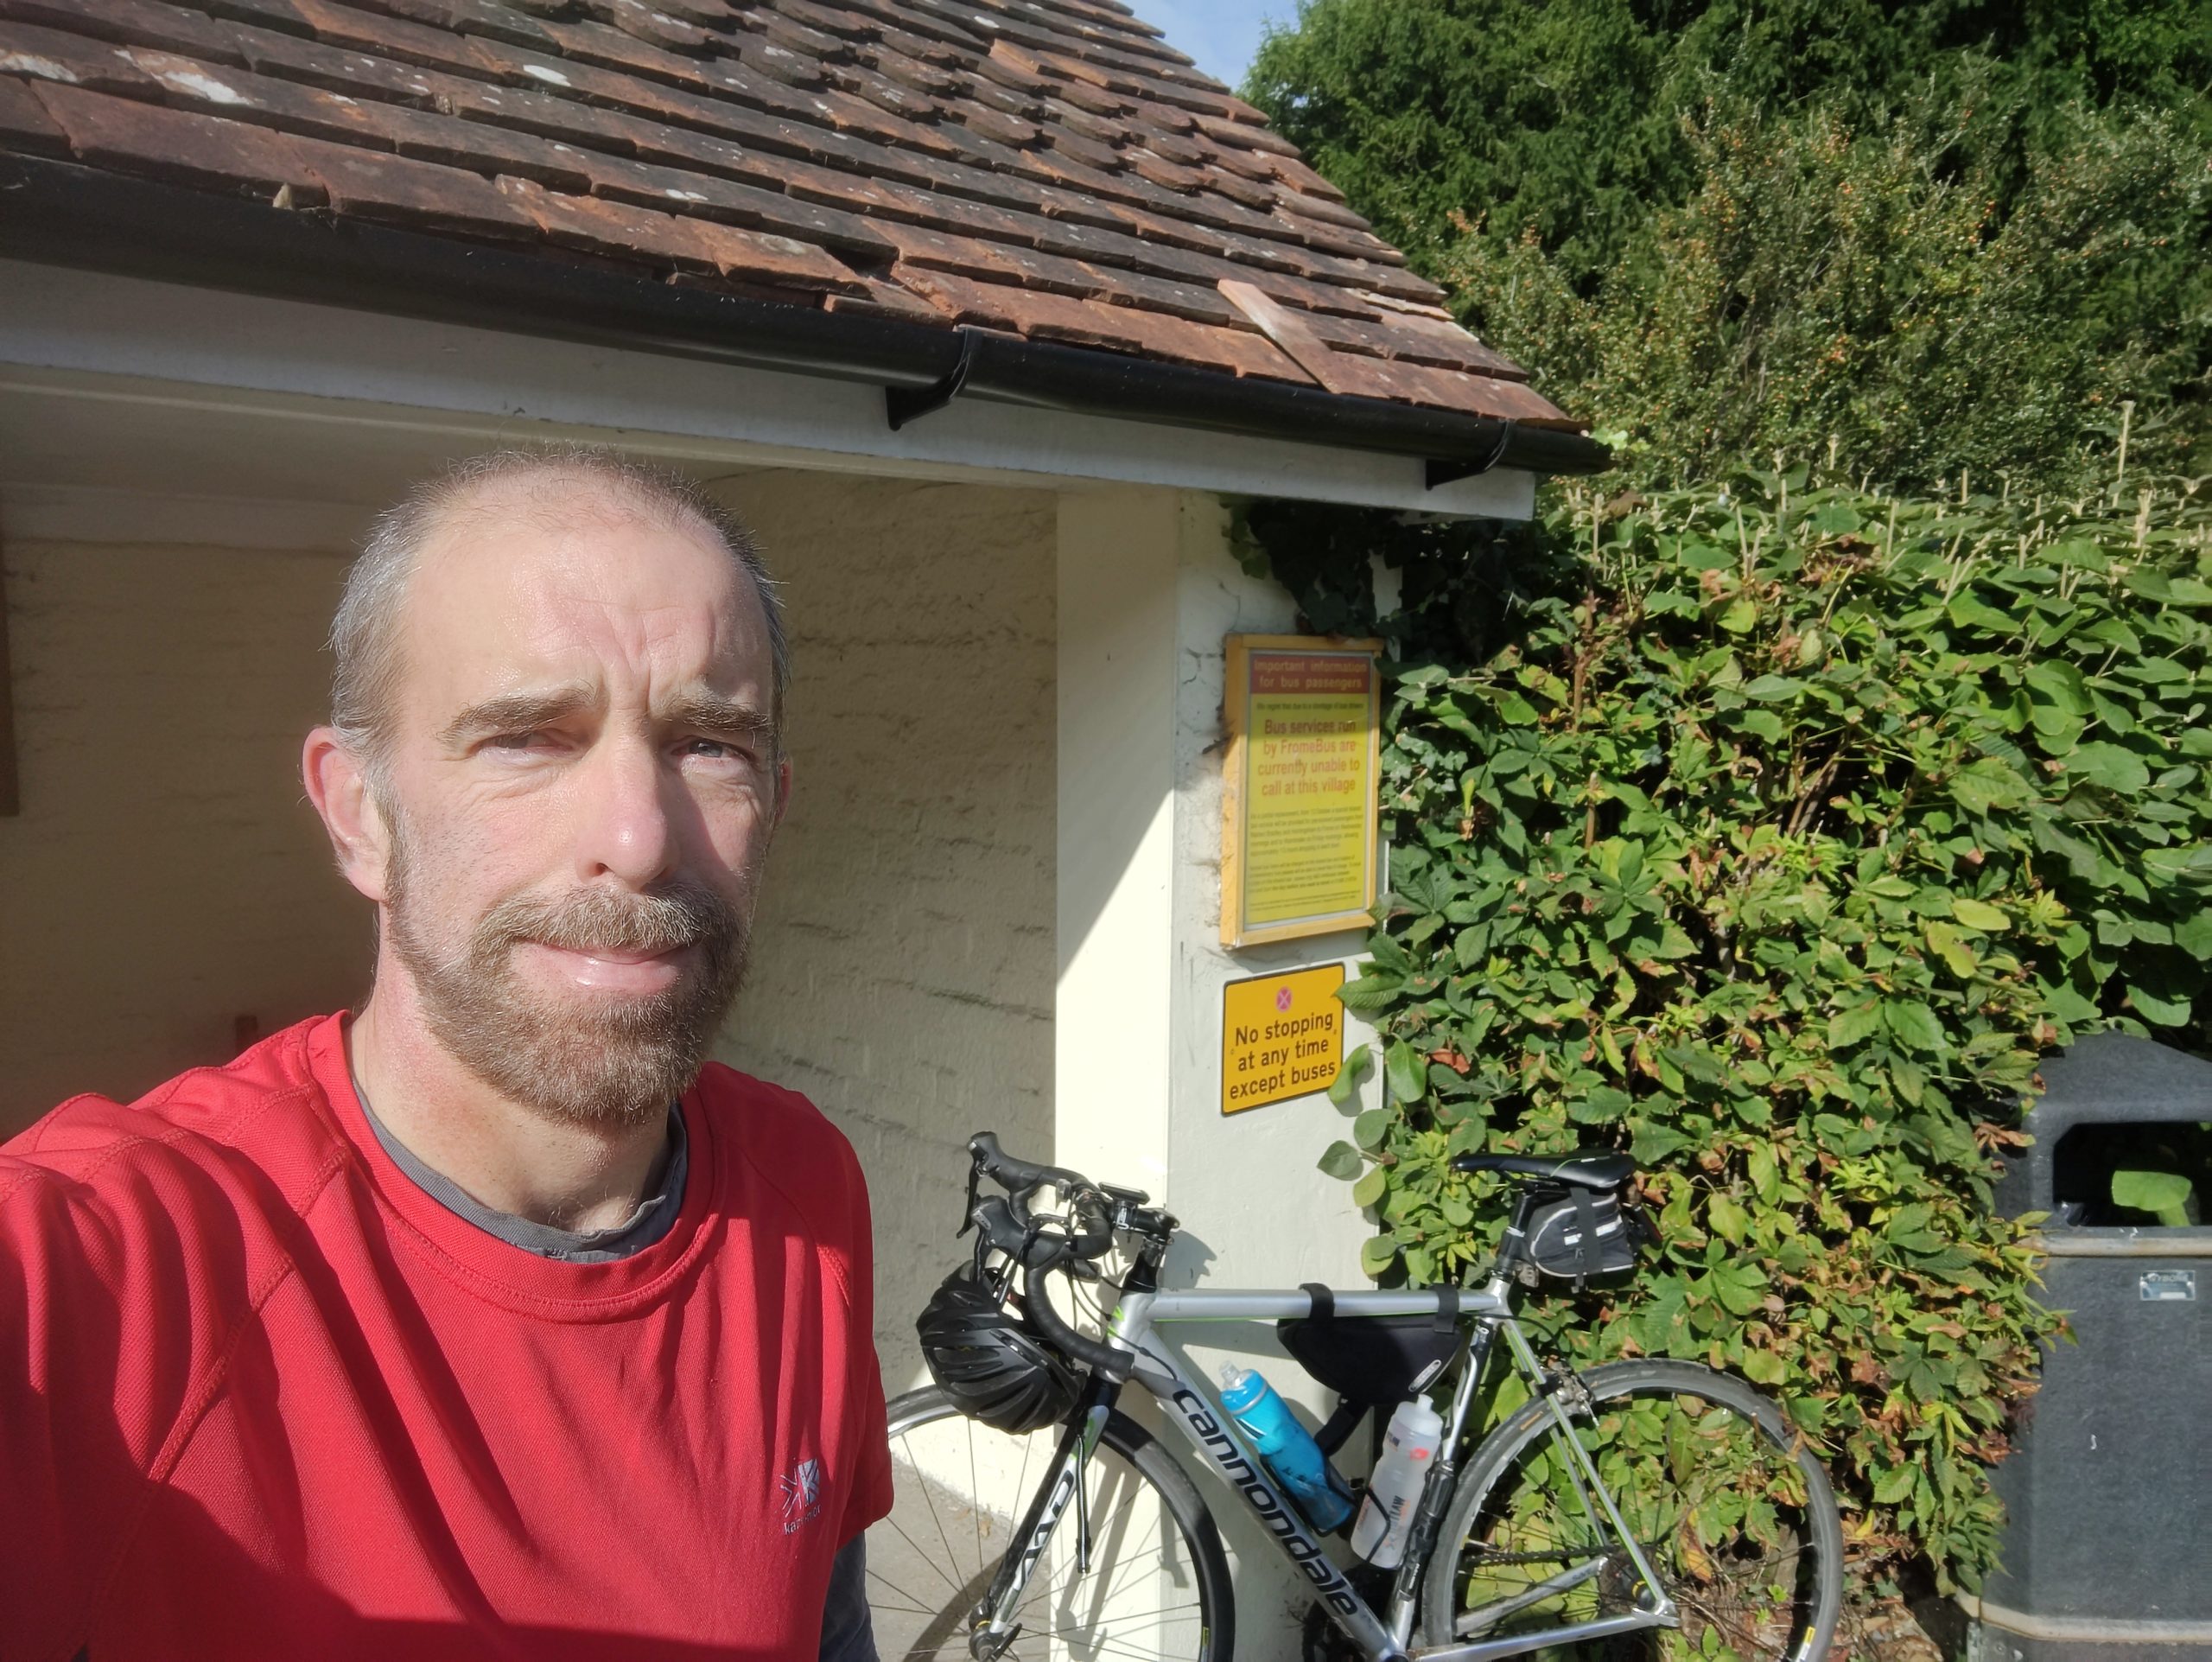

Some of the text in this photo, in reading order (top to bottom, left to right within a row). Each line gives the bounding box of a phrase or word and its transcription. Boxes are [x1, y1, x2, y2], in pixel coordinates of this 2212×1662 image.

[1254, 660, 1367, 673] Important information
[1259, 675, 1363, 691] for bus passengers
[1264, 718, 1357, 735] Bus services run
[1263, 738, 1357, 759] by FromeBus are
[1258, 757, 1361, 777] currently unable to
[1262, 777, 1357, 796] call at this village
[1236, 1012, 1334, 1047] No stopping
[1237, 1039, 1329, 1072] at any time
[1230, 1061, 1336, 1100] except buses
[1172, 1389, 1358, 1615] cannondale
